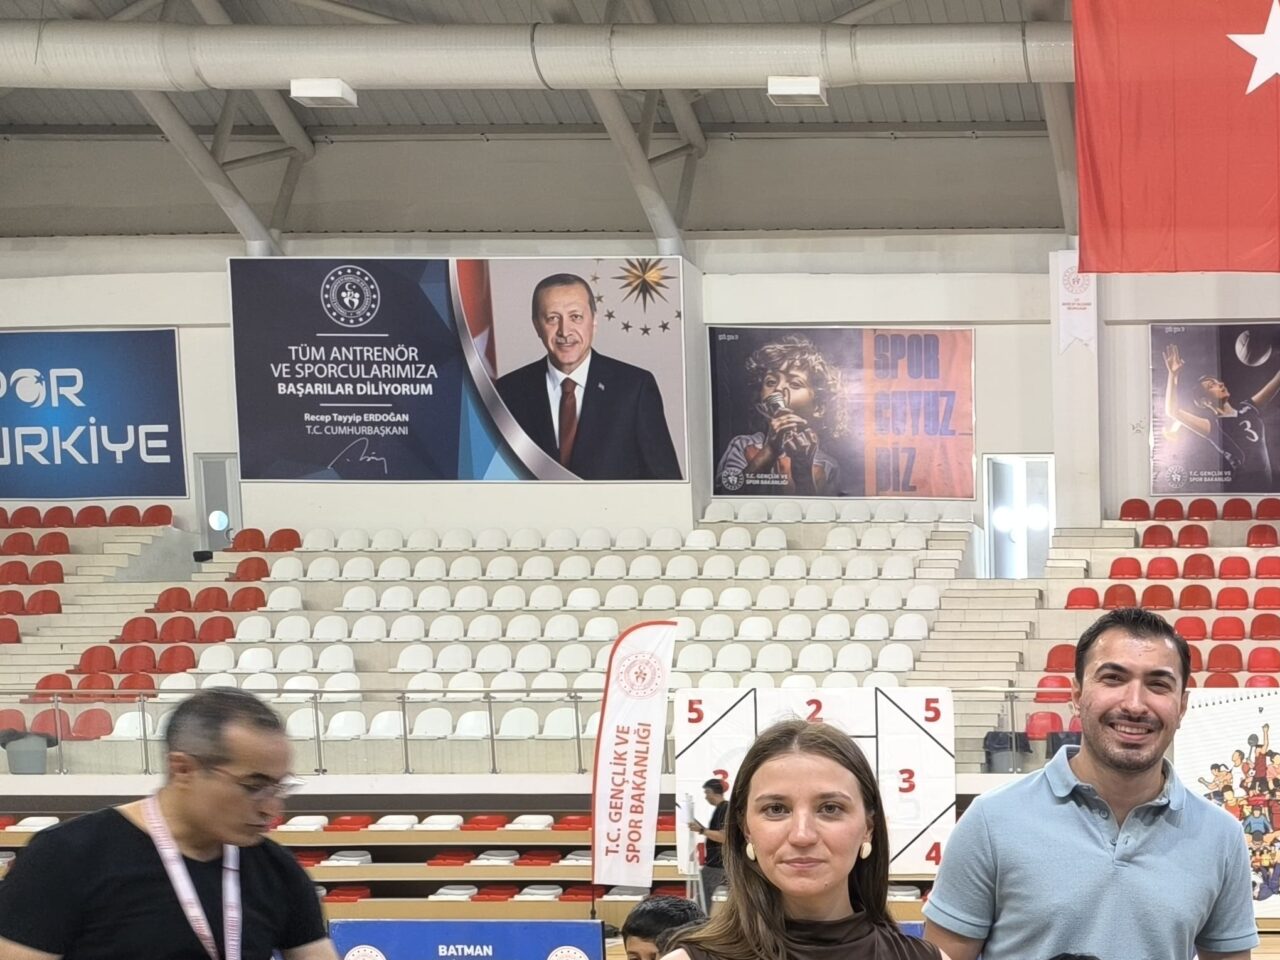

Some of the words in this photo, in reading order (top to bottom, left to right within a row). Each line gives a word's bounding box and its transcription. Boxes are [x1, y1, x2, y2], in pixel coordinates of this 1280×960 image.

[288, 344, 326, 361] TÜM
[330, 344, 419, 361] ANTRENÖR
[874, 334, 940, 379] SPOR
[270, 363, 292, 378] VE
[295, 363, 438, 379] SPORCULARIMIZA
[277, 383, 354, 398] BAŞARILAR
[356, 381, 433, 396] DİLİYORUM
[304, 413, 332, 424] Recep
[333, 413, 362, 424] Tayyip
[363, 412, 409, 422] ERDOĞAN
[874, 391, 956, 436] CUYUZ
[306, 425, 322, 435] T.C.
[324, 425, 409, 437] CUMHURBAŞKANI
[1239, 420, 1259, 442] 3
[687, 699, 704, 723] 5
[806, 699, 823, 722] 2
[924, 698, 941, 722] 5
[615, 724, 630, 747] VE
[628, 721, 652, 815] BAKANLIĞI
[609, 750, 630, 823] GENÇLİK
[898, 768, 915, 793] 3
[605, 827, 622, 857] T.C.
[625, 818, 644, 863] SPOR
[925, 841, 942, 866] 4
[438, 945, 493, 956] BATMAN
